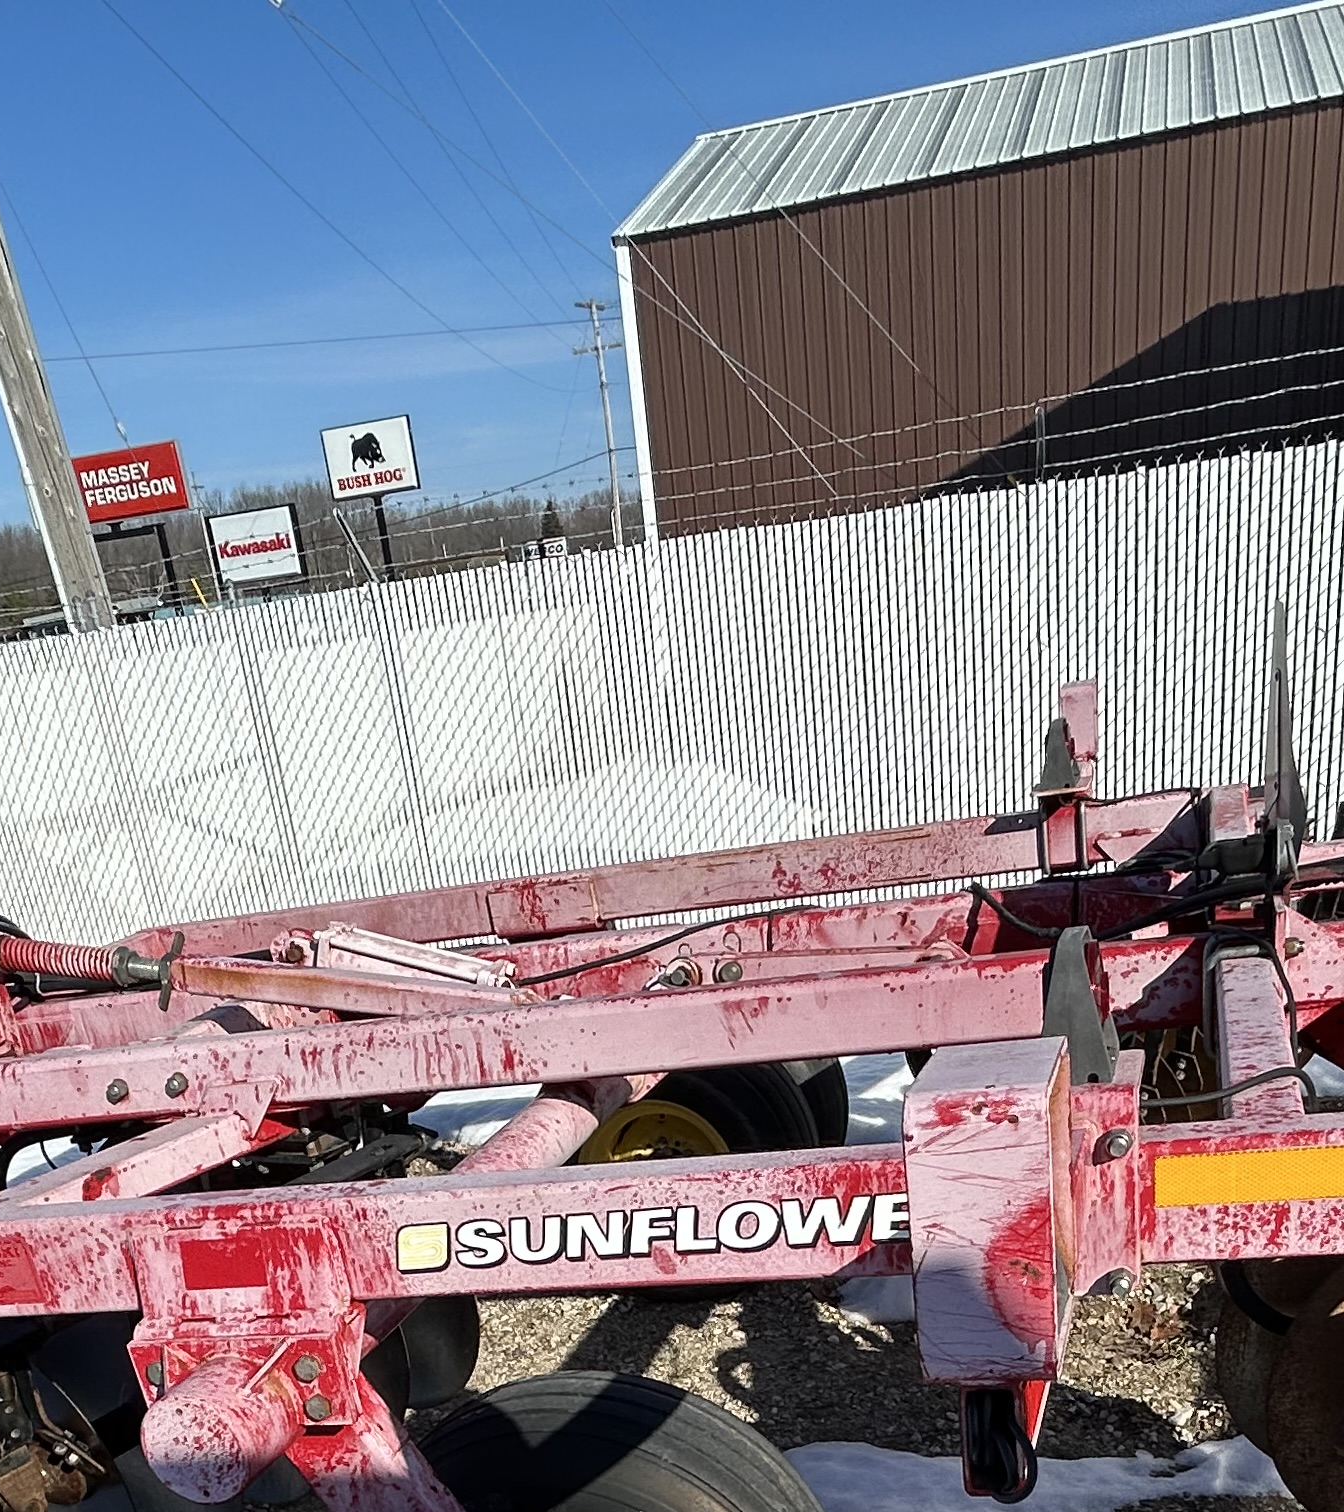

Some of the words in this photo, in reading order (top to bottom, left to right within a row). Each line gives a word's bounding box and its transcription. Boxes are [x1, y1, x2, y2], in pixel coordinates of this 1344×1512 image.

[80, 461, 149, 489] MASSEY
[337, 473, 372, 491] BUSH
[374, 468, 404, 485] HOG
[85, 476, 177, 507] FERGUSON
[218, 532, 292, 559] Kawasaki
